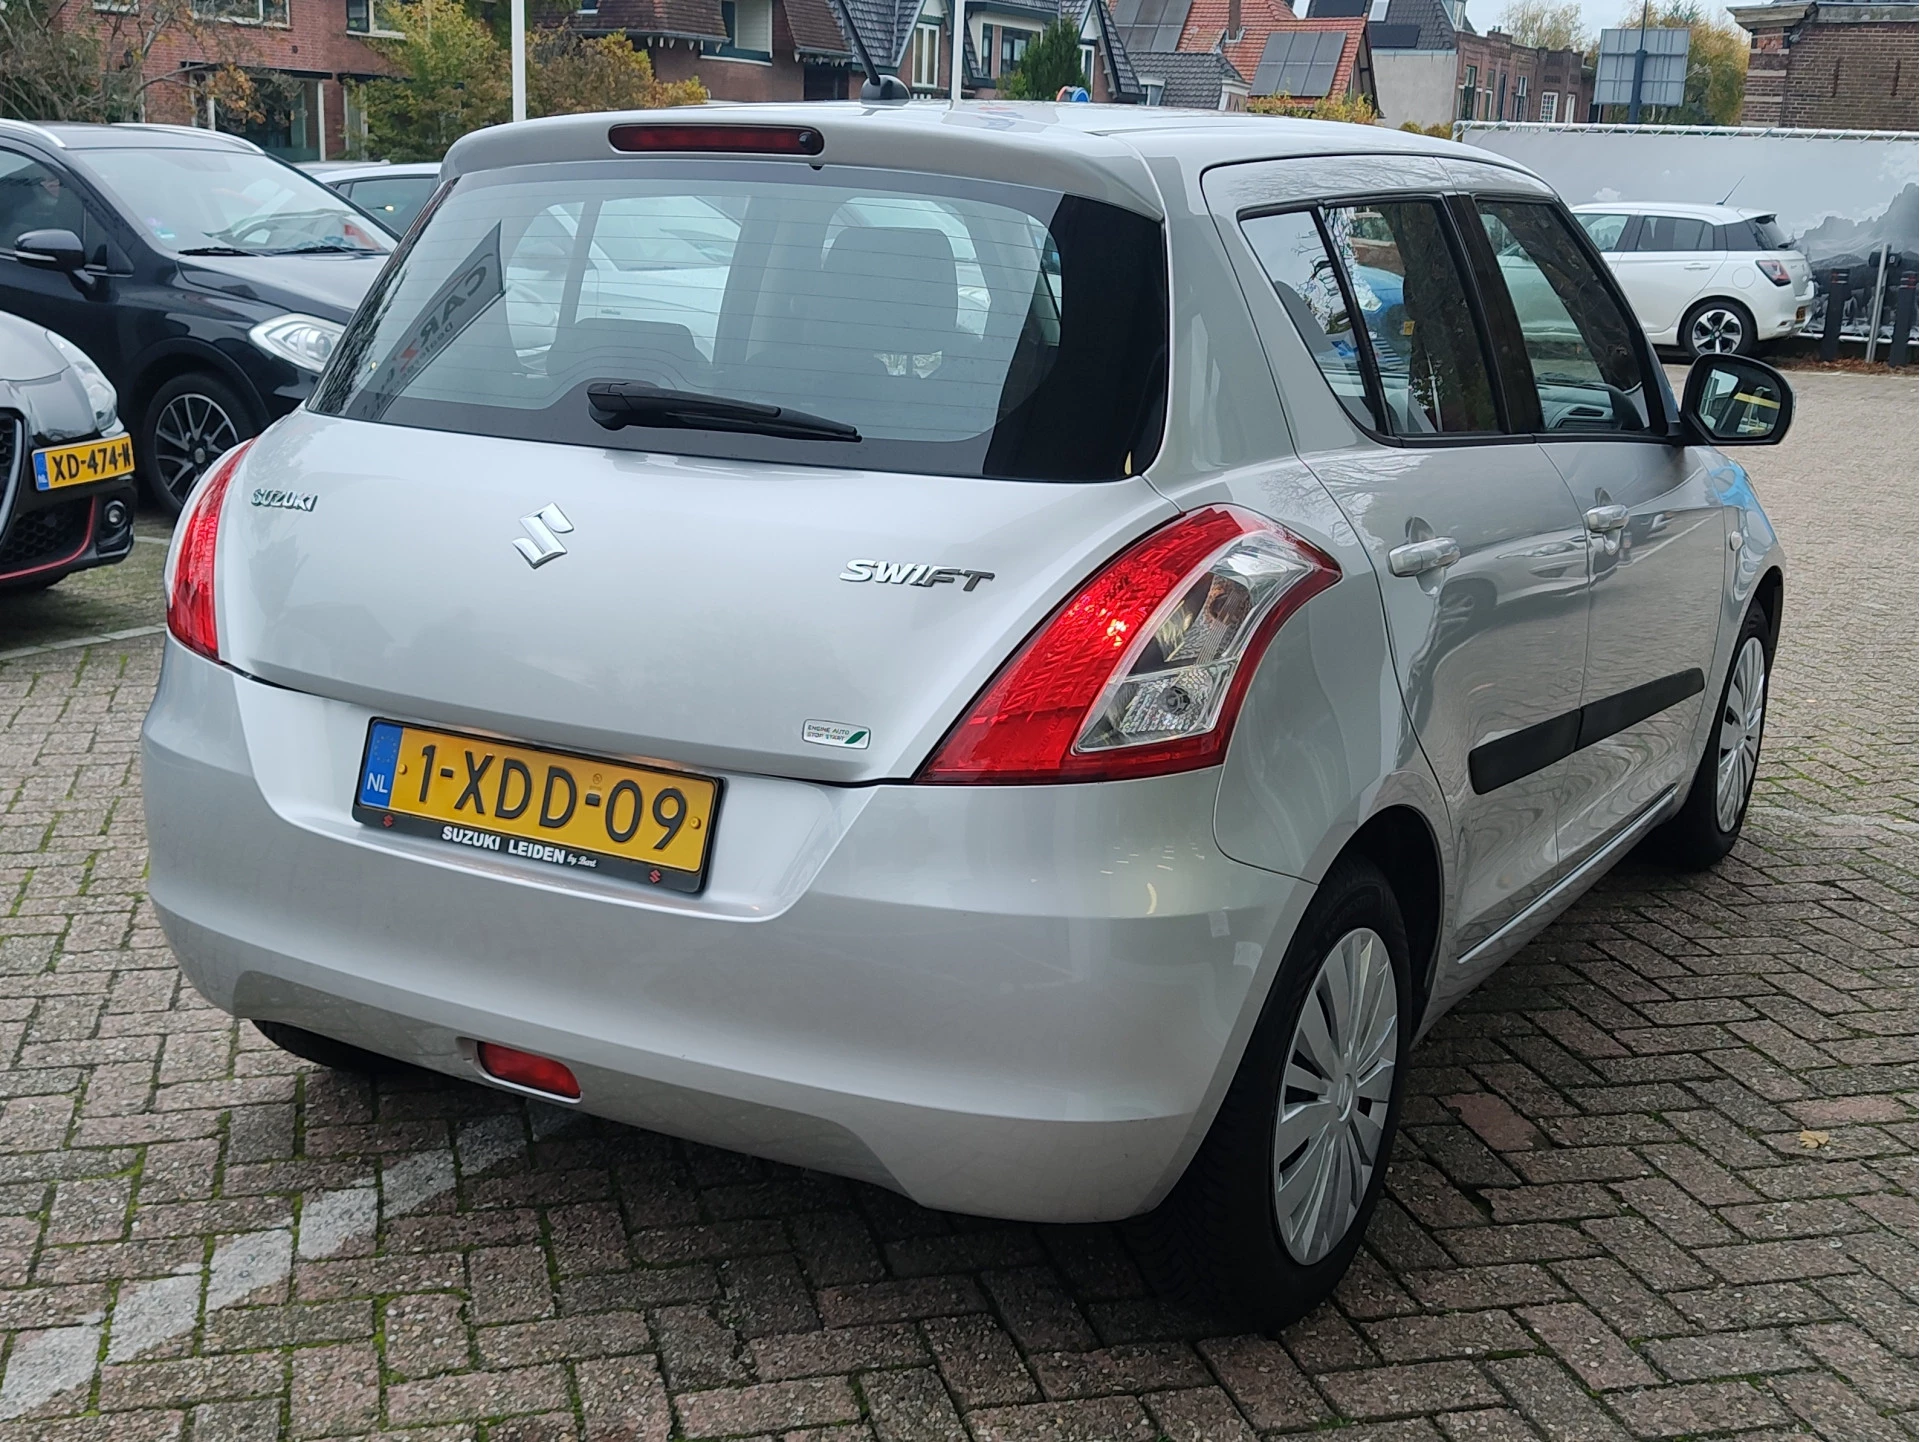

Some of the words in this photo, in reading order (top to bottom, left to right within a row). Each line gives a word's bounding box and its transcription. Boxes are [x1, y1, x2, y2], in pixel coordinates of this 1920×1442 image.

[251, 488, 318, 512] SUZUKI
[839, 558, 995, 592] SWIFT
[807, 724, 831, 734] ENGINE
[832, 727, 850, 736] AUTO
[825, 733, 845, 741] START
[366, 772, 389, 794] NL
[418, 744, 687, 850] 1-XDD-09
[442, 826, 501, 851] SUZUKI
[508, 839, 566, 864] LEIDEN
[567, 853, 577, 866] by
